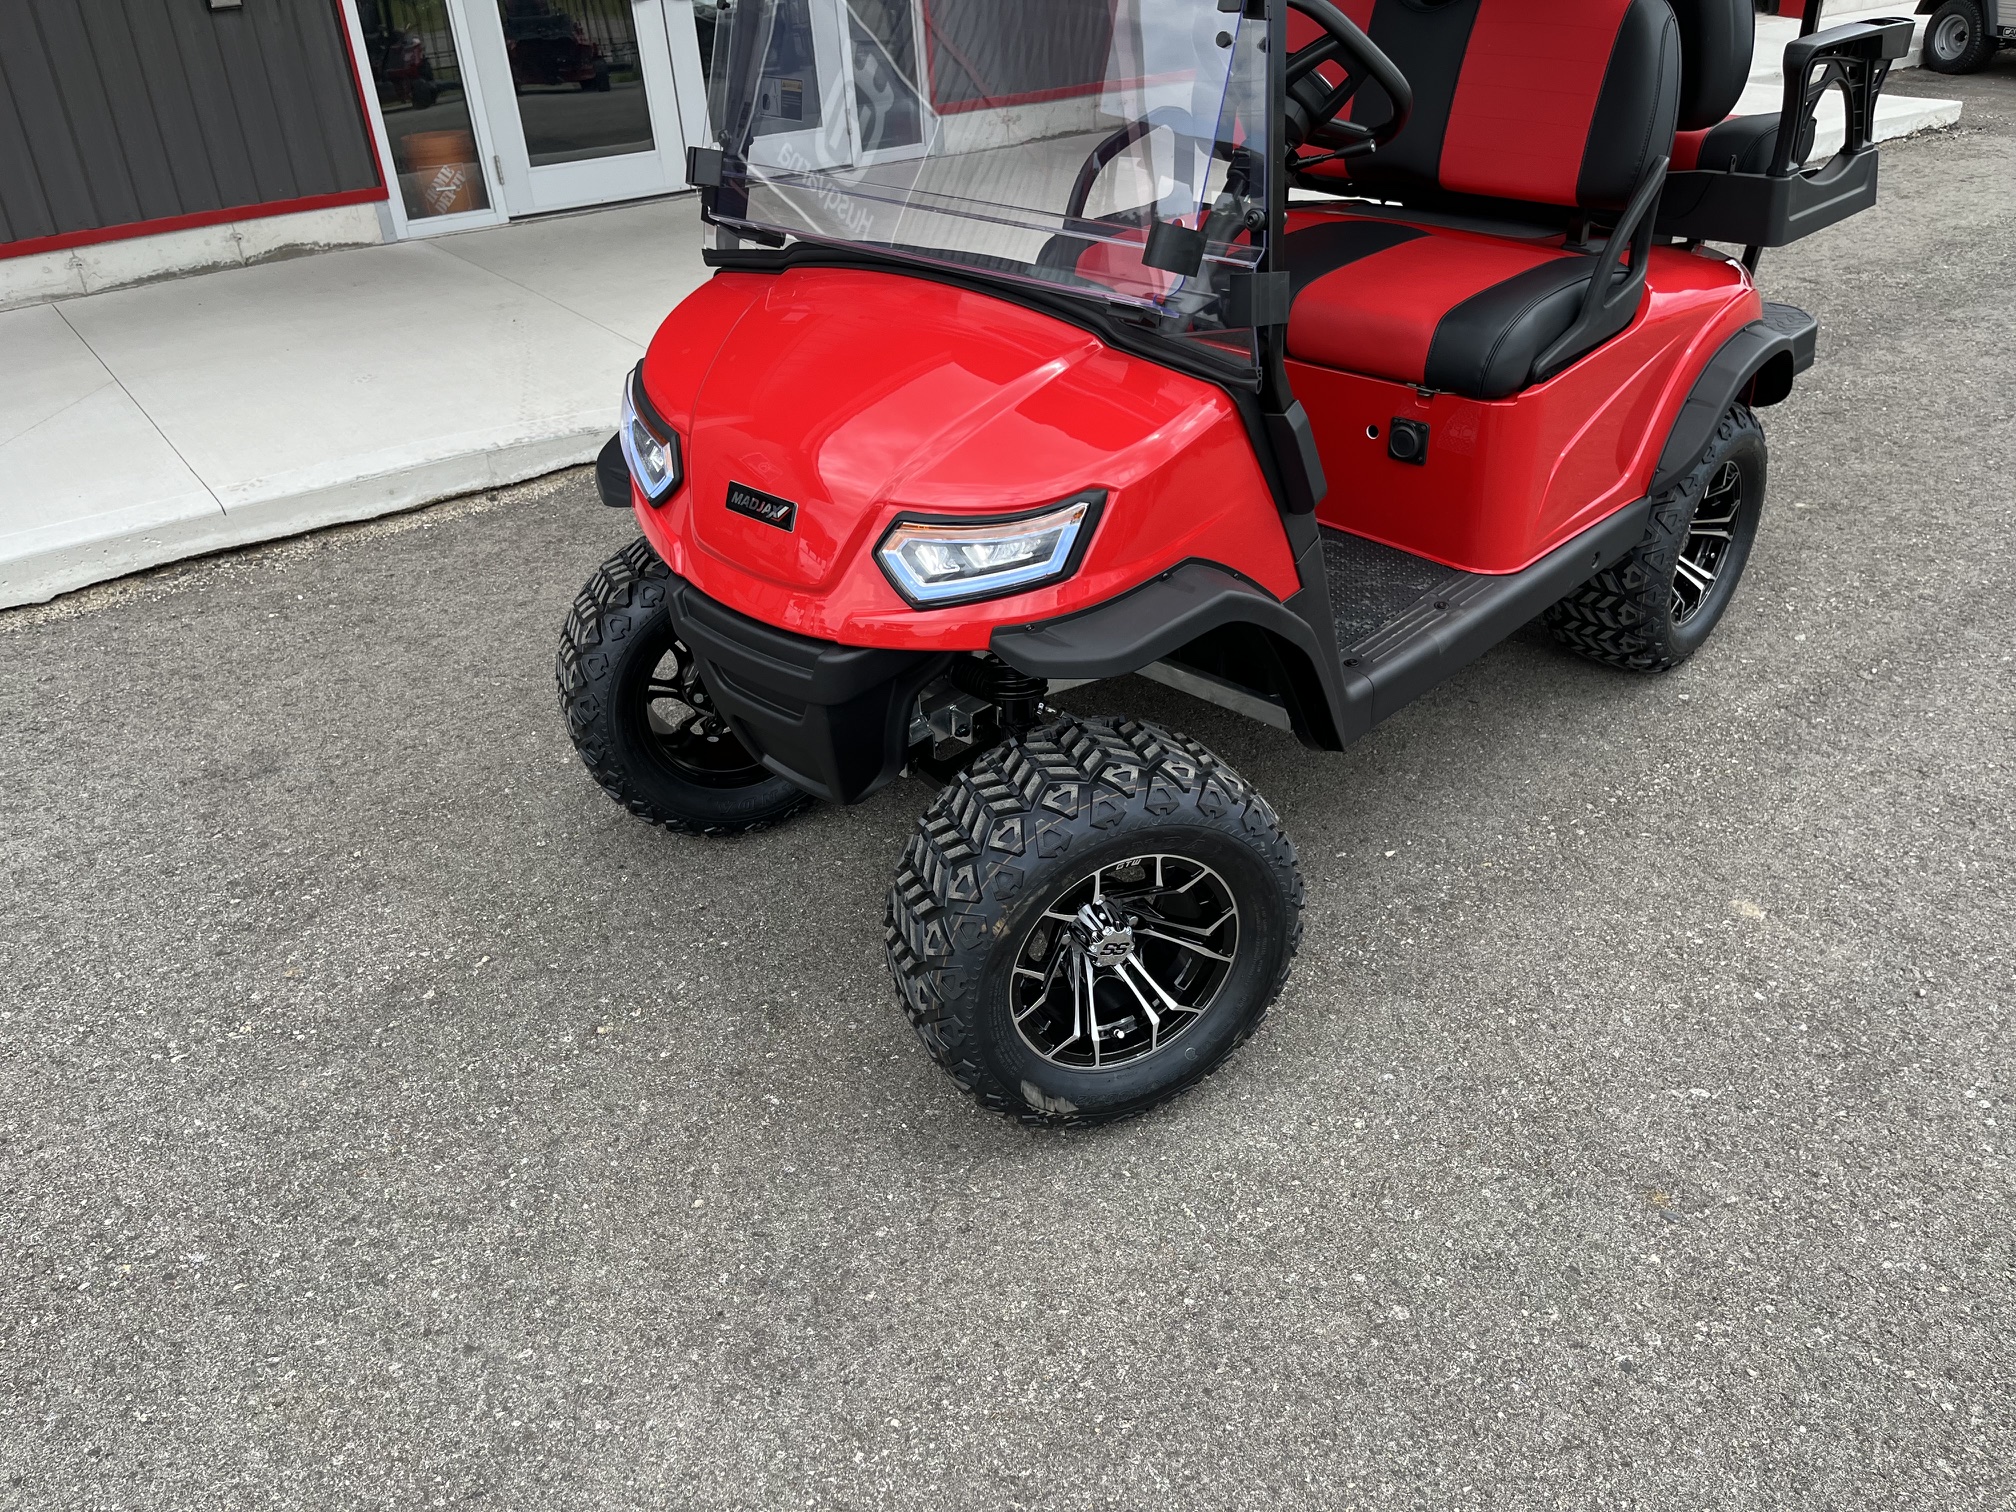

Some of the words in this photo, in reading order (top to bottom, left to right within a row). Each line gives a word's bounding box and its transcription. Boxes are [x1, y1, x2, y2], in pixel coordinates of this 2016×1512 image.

[425, 165, 455, 204] HOME
[731, 491, 791, 521] MADJAX
[1115, 858, 1142, 871] GTW
[1100, 942, 1130, 956] SS
